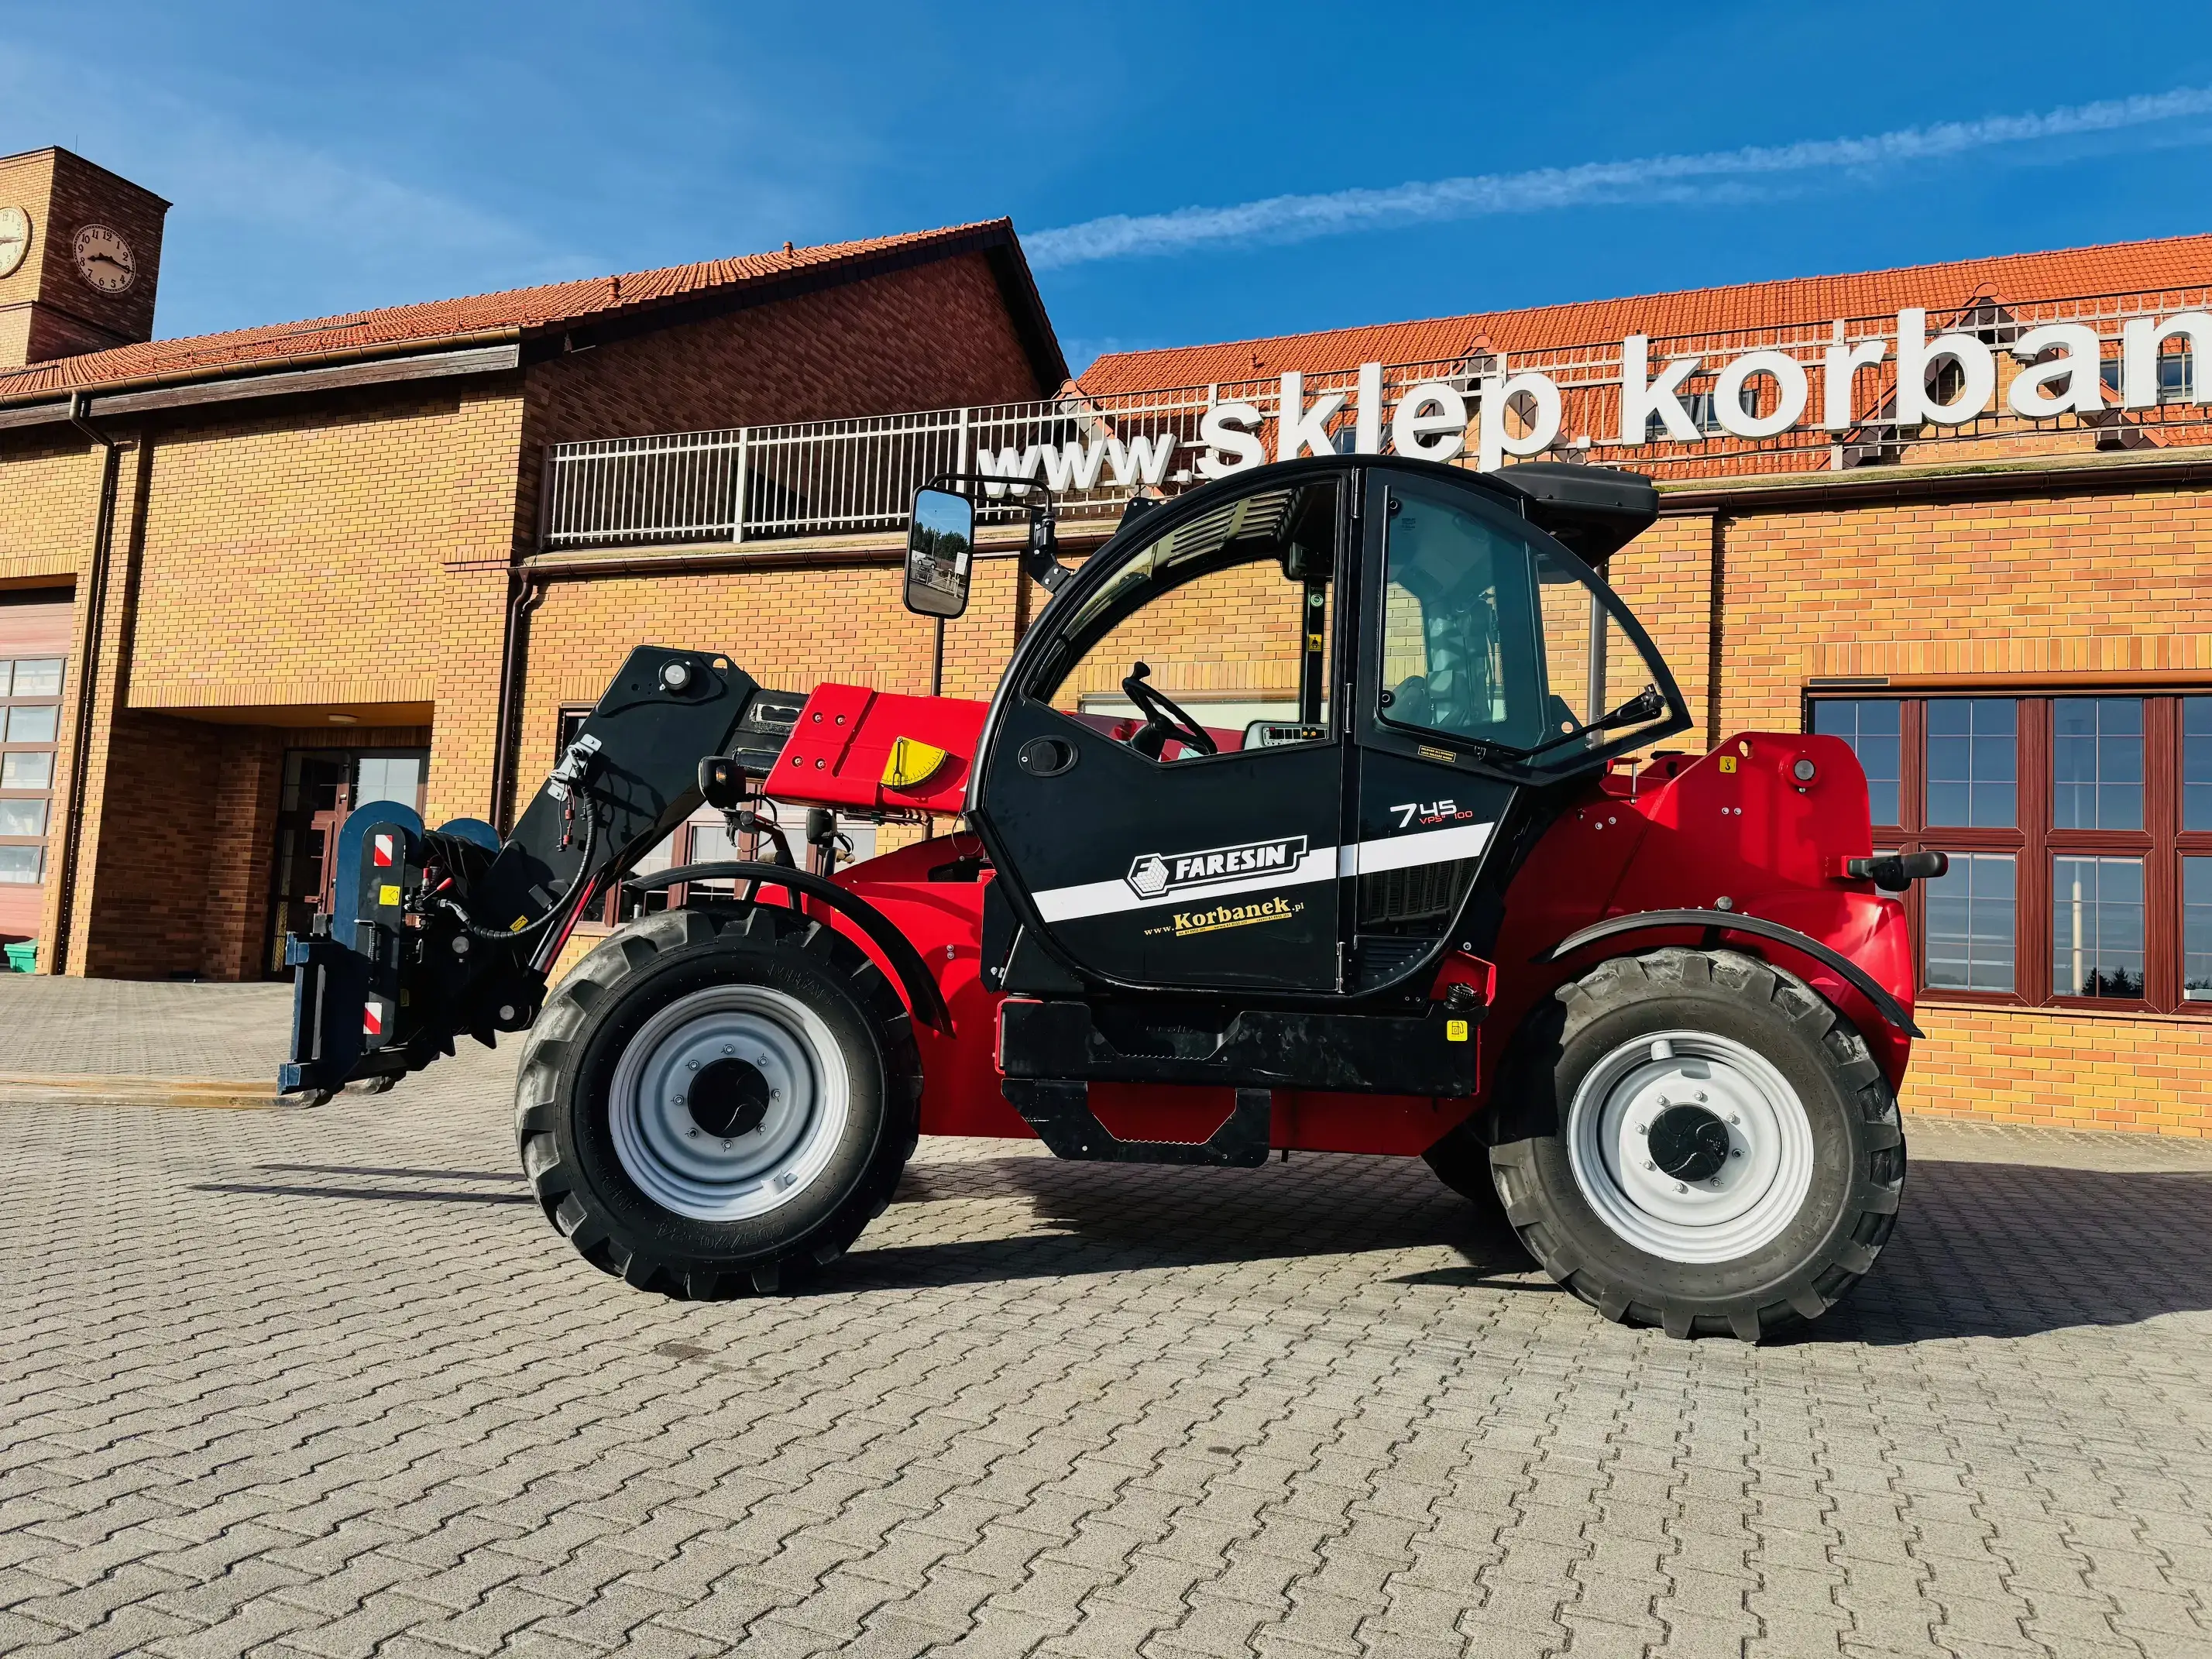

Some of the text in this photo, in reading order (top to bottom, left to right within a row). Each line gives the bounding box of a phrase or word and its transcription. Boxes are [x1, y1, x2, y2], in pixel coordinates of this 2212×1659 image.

[81, 233, 90, 243] 10
[91, 229, 98, 239] 11
[102, 231, 112, 242] 12
[78, 244, 84, 252] 9
[116, 241, 120, 249] 1
[80, 257, 85, 266] 8
[122, 252, 129, 261] 2
[88, 268, 93, 278] 7
[99, 277, 105, 286] 6
[110, 279, 116, 288] 5
[120, 274, 125, 284] 4
[1389, 799, 1457, 828] 745
[1455, 810, 1473, 819] 100
[1175, 844, 1287, 881] FARESIN
[1144, 896, 1305, 936] www.Korbanek.pl
